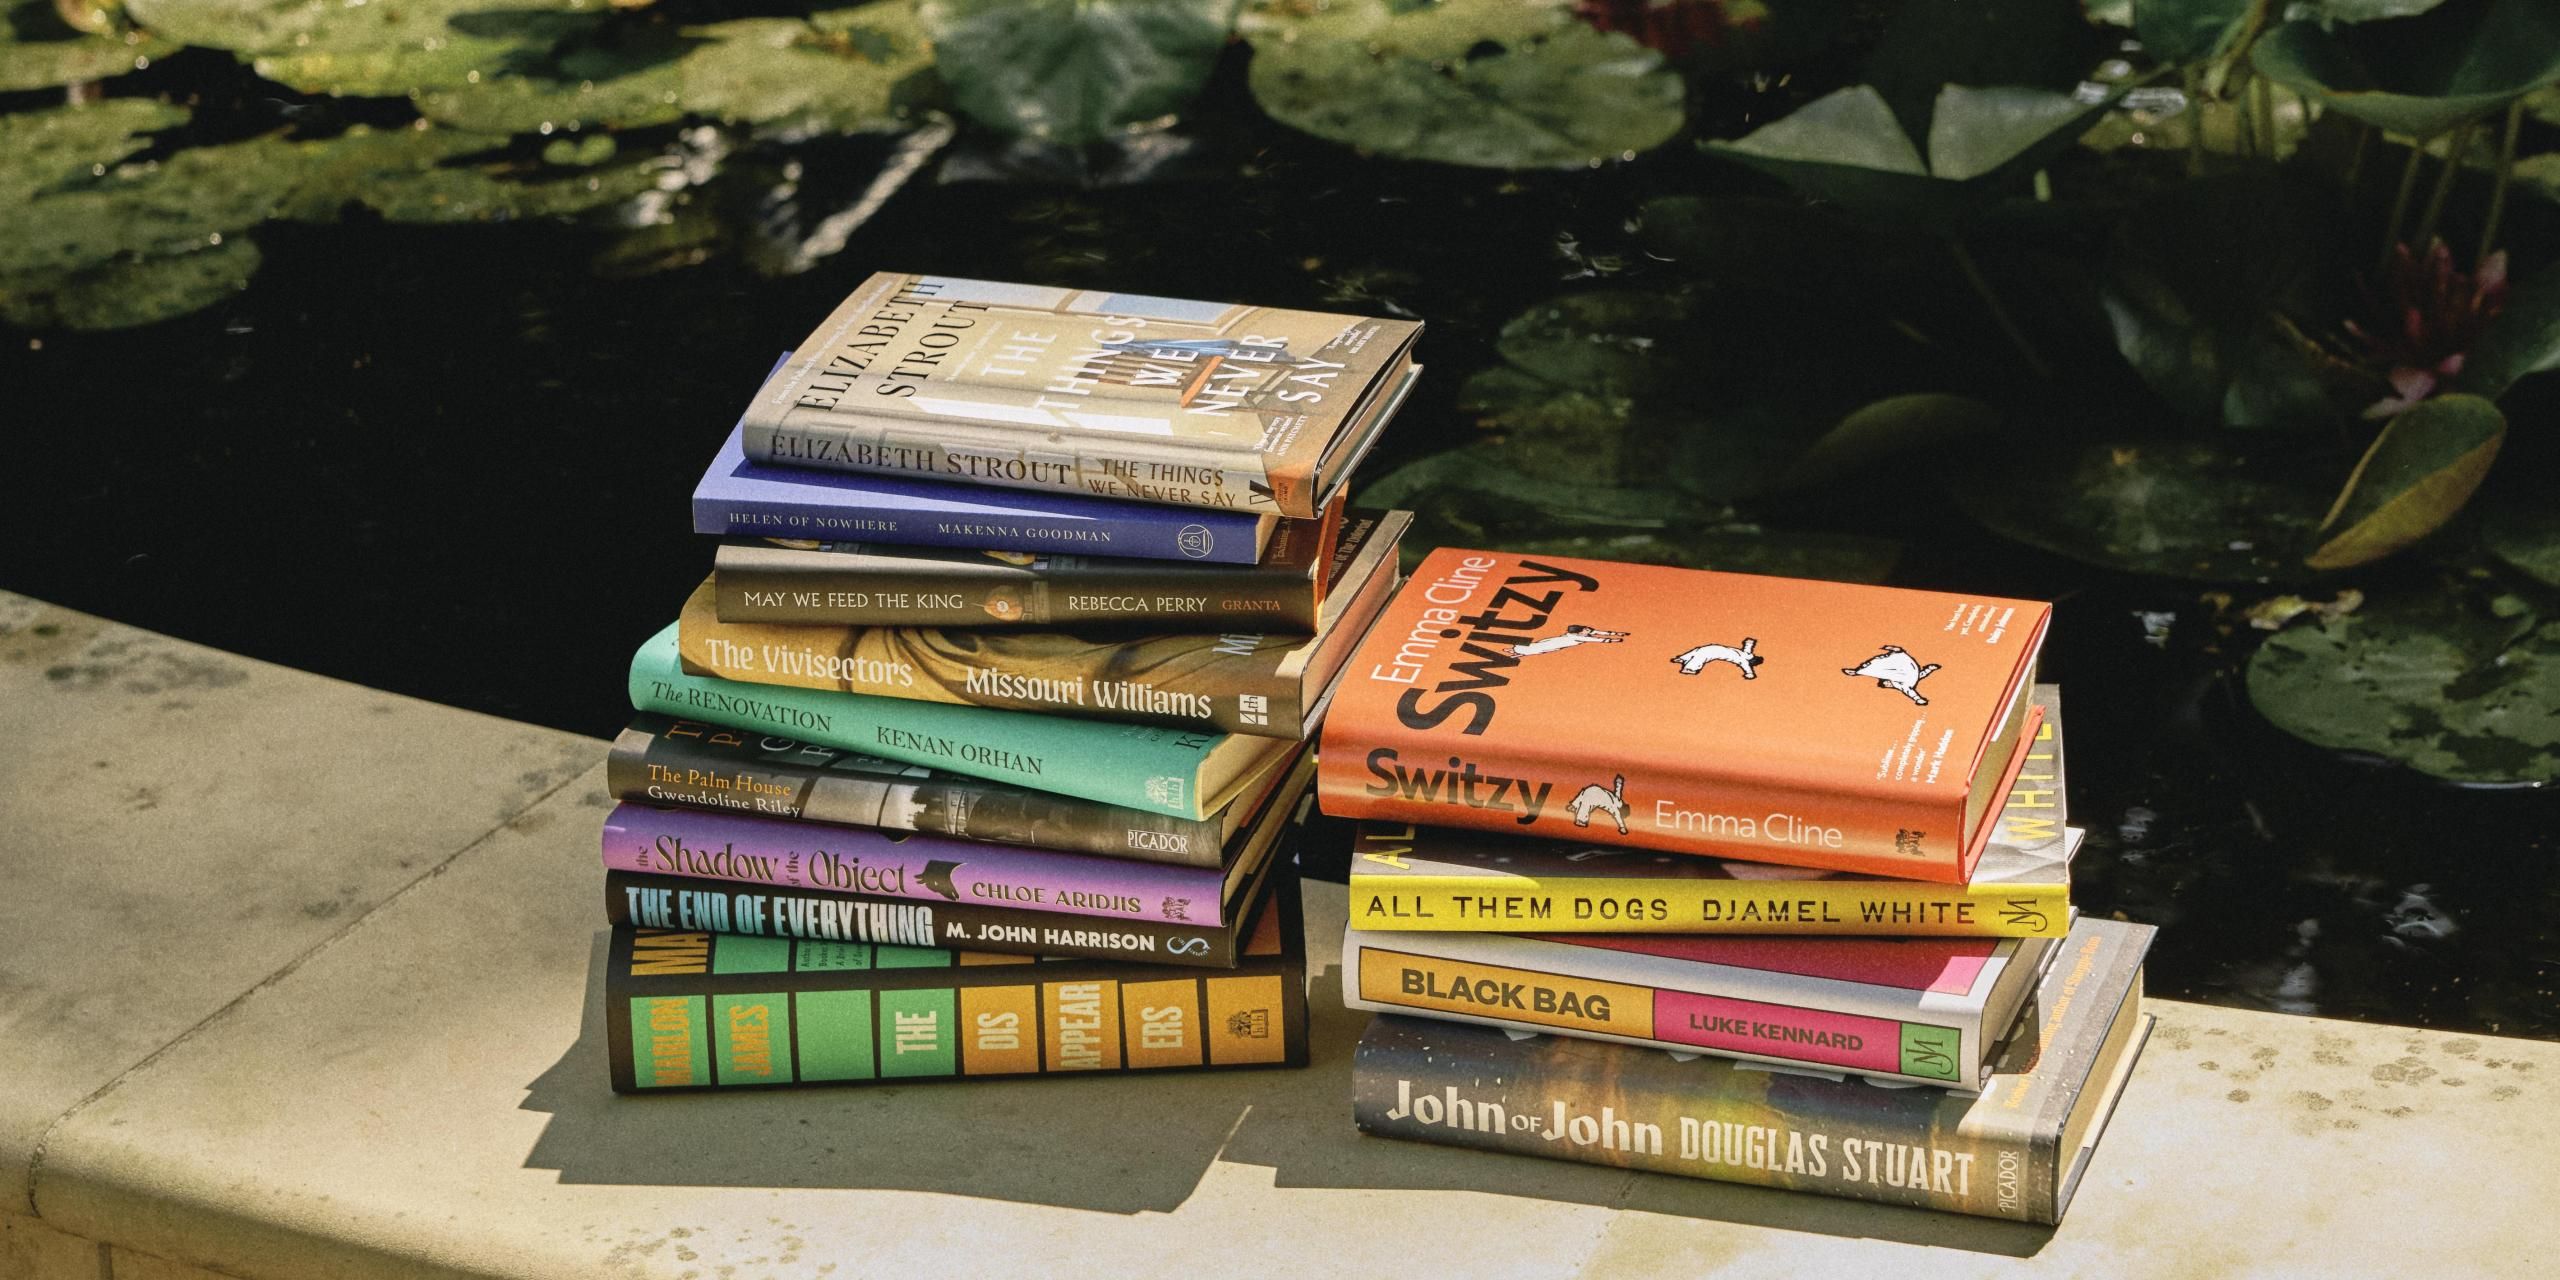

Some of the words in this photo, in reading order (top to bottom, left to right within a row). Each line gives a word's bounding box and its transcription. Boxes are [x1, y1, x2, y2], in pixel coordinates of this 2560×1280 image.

[794, 281, 944, 411] ELIZABETH
[876, 300, 989, 398] STROUT
[981, 330, 1057, 377] THE
[1033, 315, 1147, 410] THINGS
[1129, 348, 1199, 386] WE
[1185, 334, 1288, 417] NEVER
[1278, 356, 1346, 403] SAY
[771, 435, 934, 472] ELIZABETH
[947, 452, 1072, 486] STROUT
[1102, 458, 1139, 478] THE
[1150, 463, 1224, 487] THINGS
[1088, 479, 1117, 495] WE
[1127, 482, 1198, 503] NEVER
[1201, 491, 1236, 507] SAY
[730, 512, 783, 526] HELEN
[789, 515, 811, 528] OF
[816, 518, 898, 532] NOWHERE
[938, 523, 1019, 538] MAKENNA
[1025, 527, 1112, 543] GOODMAN
[744, 591, 786, 607] MAY
[792, 592, 821, 608] WE
[828, 592, 869, 608] FEED
[874, 593, 910, 609] THE
[917, 594, 964, 609] KING
[1069, 595, 1149, 613] REBECCA
[1156, 596, 1208, 613] PERRY
[1222, 600, 1281, 612] GRANTA
[1370, 607, 1458, 684] Emma
[1424, 556, 1497, 605] Cline
[705, 638, 754, 671] The
[762, 643, 914, 688] Vivisectors
[1396, 560, 1600, 736] Switzy
[652, 681, 683, 703] The
[688, 687, 833, 733] RENOVATION
[965, 666, 1085, 706] Missouri
[1093, 680, 1212, 719] Williams
[876, 726, 955, 757] KENAN
[960, 743, 1043, 775] ORHAN
[1932, 728, 1955, 760] Haddon
[648, 764, 682, 784] The
[688, 769, 730, 789] Palm
[736, 775, 792, 797] House
[1365, 748, 1553, 825] Switzy
[1925, 760, 1943, 784] Mark
[2006, 723, 2057, 841] WHI
[648, 785, 750, 810] Gwendoline
[756, 798, 801, 819] Riley
[1655, 800, 1757, 839] Emma
[1764, 813, 1843, 849] Cline
[635, 846, 649, 867] the
[655, 834, 779, 882] Shadow
[786, 850, 800, 873] the
[808, 849, 908, 894] Object
[1128, 830, 1189, 854] PICADOR
[1363, 827, 1415, 870] AL
[626, 886, 675, 929] THE
[679, 889, 731, 933] END
[735, 894, 766, 935] OF
[773, 897, 936, 947] EVERYTHING
[971, 881, 1047, 905] CHLOE
[1055, 890, 1143, 914] ARIDJIS
[1366, 895, 1434, 918] ALL
[1452, 896, 1552, 919] THEM
[1574, 897, 1668, 920] DOGS
[1703, 899, 1841, 923] DJAMEL
[1860, 901, 1975, 924] WHITE
[946, 921, 971, 940] M.
[977, 923, 1037, 944] JOHN
[1044, 928, 1155, 952] HARRISON
[1401, 968, 1530, 1012] BLACK
[1533, 987, 1611, 1022] BAG
[651, 998, 692, 1086] MARLON
[729, 1004, 772, 1078] JAMES
[895, 1010, 937, 1055] THE
[977, 1010, 1020, 1051] DIS
[1059, 983, 1101, 1069] APPEAR
[1140, 1006, 1184, 1049] ERS
[1690, 1013, 1749, 1037] LUKE
[1752, 1022, 1863, 1052] KENNARD
[1386, 1080, 1506, 1135] John
[1511, 1114, 1542, 1133] OF
[1541, 1101, 1663, 1155] John
[1680, 1115, 1828, 1177] DOUGLAS
[1842, 1137, 1974, 1196] STUART
[1999, 1150, 2020, 1212] PICADOR
